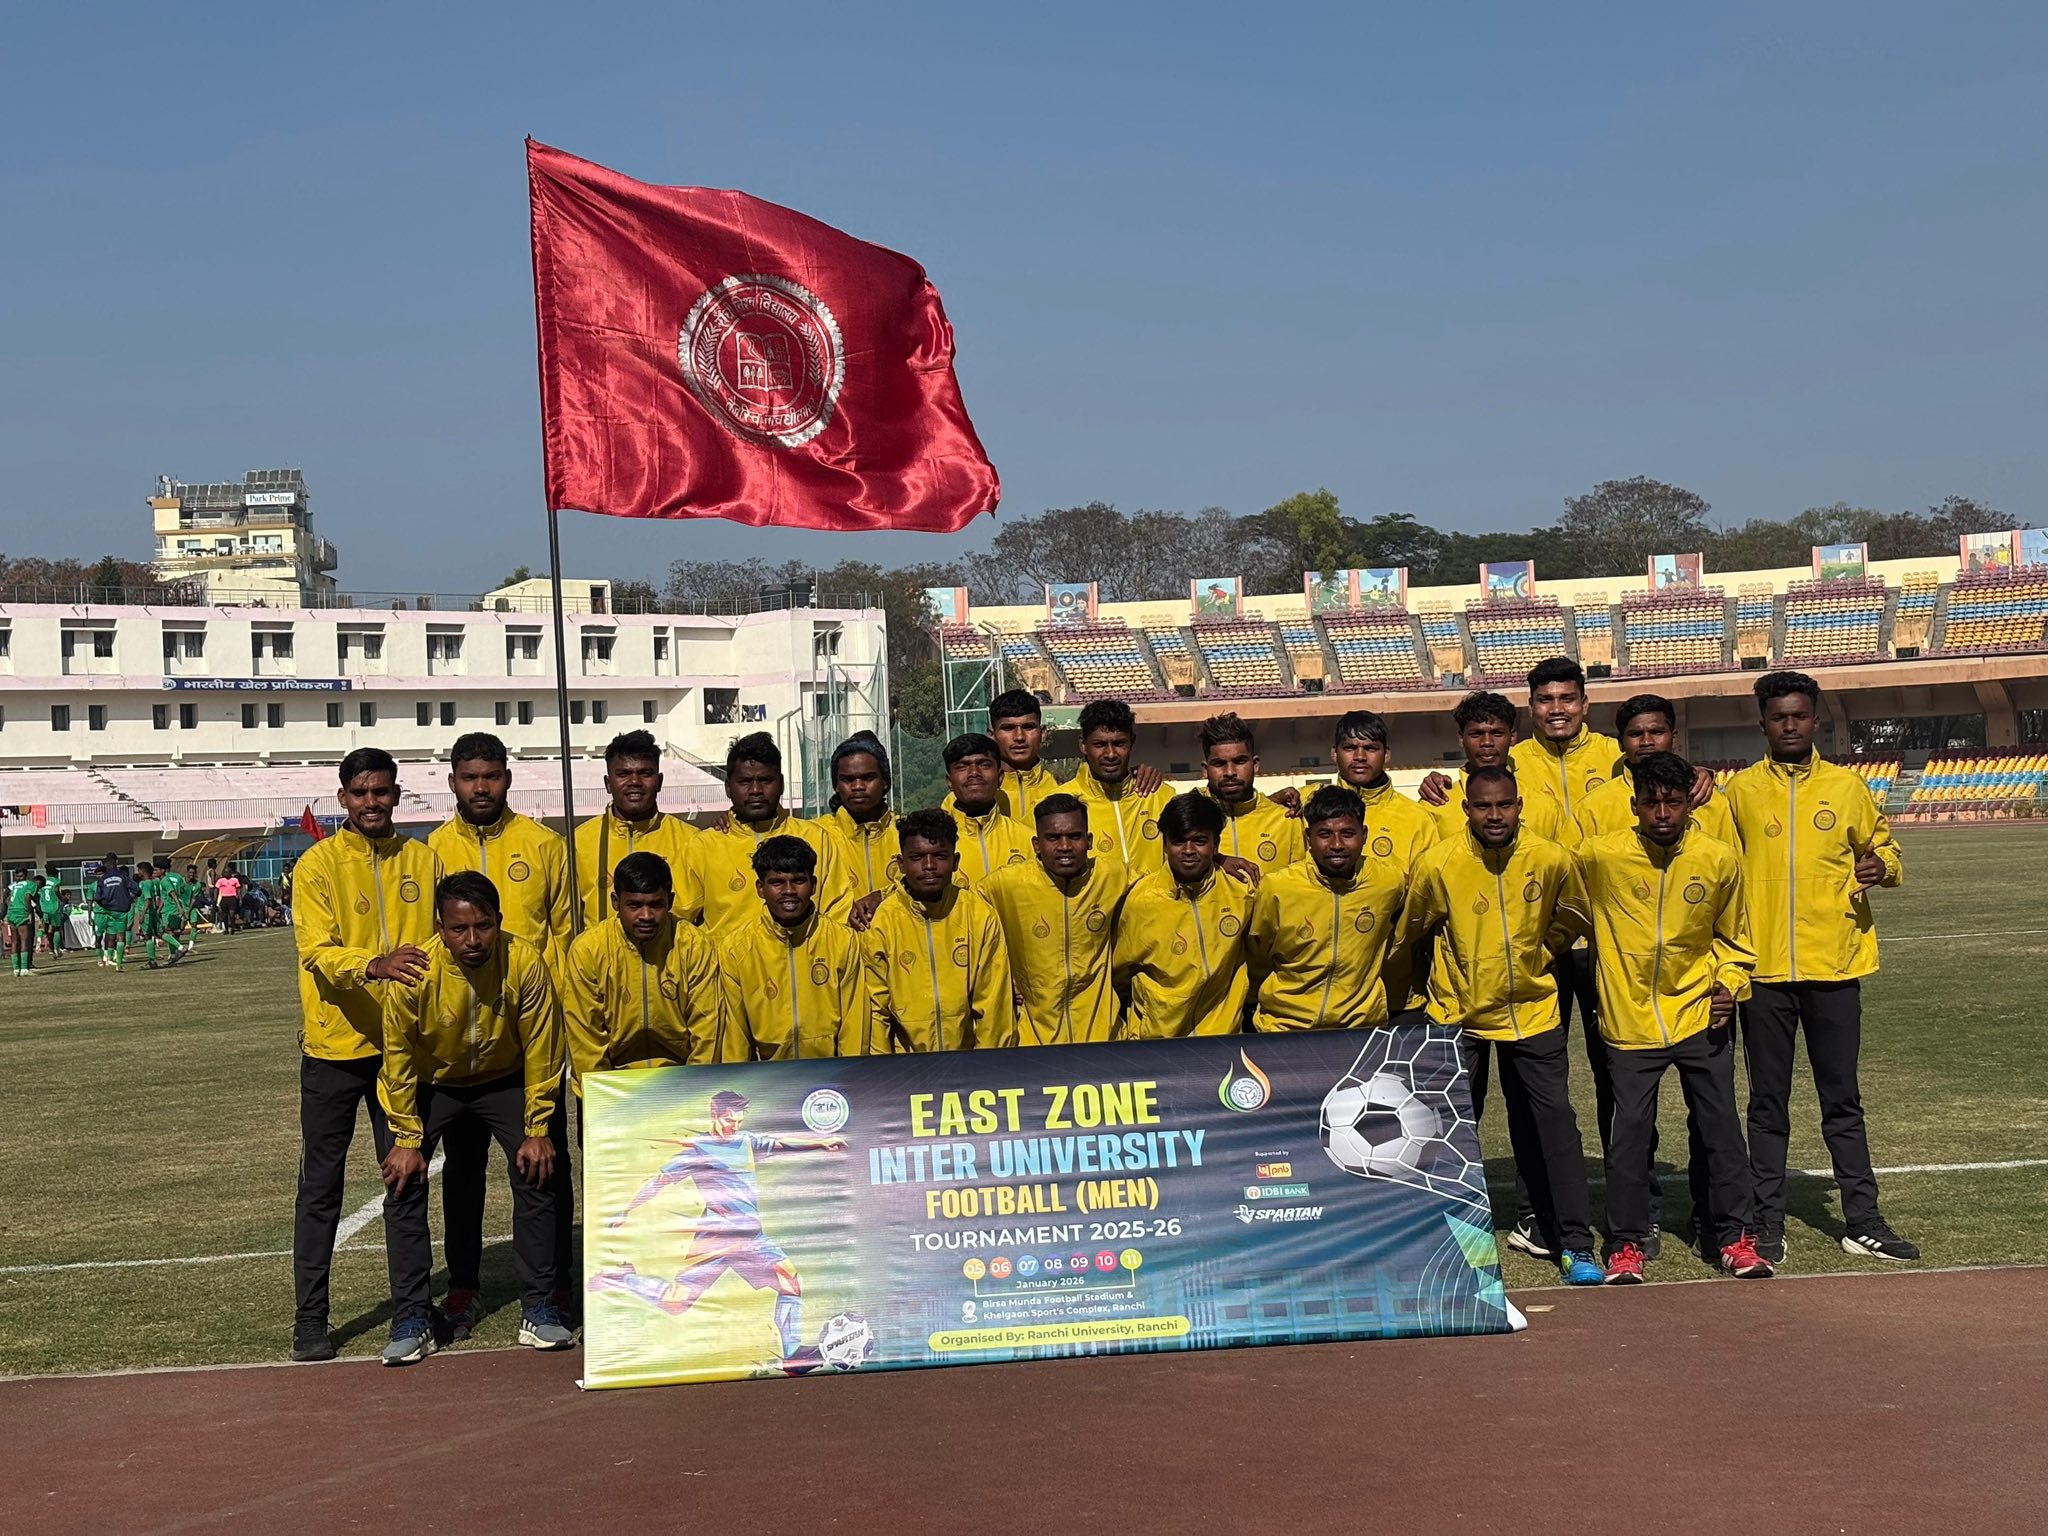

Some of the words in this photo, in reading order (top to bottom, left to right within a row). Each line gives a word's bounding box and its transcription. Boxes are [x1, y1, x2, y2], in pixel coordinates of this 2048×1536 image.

[250, 494, 267, 503] Park
[269, 494, 292, 503] Prime
[183, 678, 235, 690] भारतीय
[238, 678, 269, 691] खेल
[271, 679, 334, 691] प्राधिकरण
[910, 1087, 1025, 1138] EAST
[1042, 1081, 1161, 1130] ZONE
[869, 1142, 979, 1185] INTER
[988, 1129, 1206, 1179] UNIVERSITY
[1271, 1165, 1290, 1176] pnb
[926, 1183, 1067, 1220] FOOTBALL
[1076, 1177, 1160, 1214] (MEN)
[1261, 1187, 1283, 1197] IDBI
[1284, 1186, 1308, 1196] BANK
[1254, 1206, 1324, 1220] SPARTAN
[909, 1224, 1084, 1251] TOURNAMENT
[1090, 1218, 1182, 1242] 2025-26
[966, 1263, 983, 1275] 05
[991, 1261, 1010, 1273] 06
[1018, 1259, 1037, 1272] 07
[1044, 1258, 1063, 1270] 08
[1069, 1256, 1089, 1268] 09
[1097, 1255, 1115, 1266] 10
[1124, 1254, 1138, 1265] 11
[1015, 1278, 1058, 1290] January
[1059, 1276, 1085, 1287] 2026
[982, 1299, 1007, 1308] Birsa
[1008, 1296, 1042, 1307] Munda
[1044, 1293, 1083, 1304] Football
[1084, 1291, 1125, 1302] Stadium
[1126, 1291, 1134, 1299] &
[983, 1310, 1030, 1321] Khelgaon
[1112, 1300, 1146, 1312] Ranchi
[940, 1332, 1003, 1346] Organised
[1006, 1331, 1025, 1342] By:
[1027, 1326, 1068, 1340] Ranchi
[1071, 1323, 1134, 1337] University,
[1137, 1320, 1178, 1333] Ranchi
